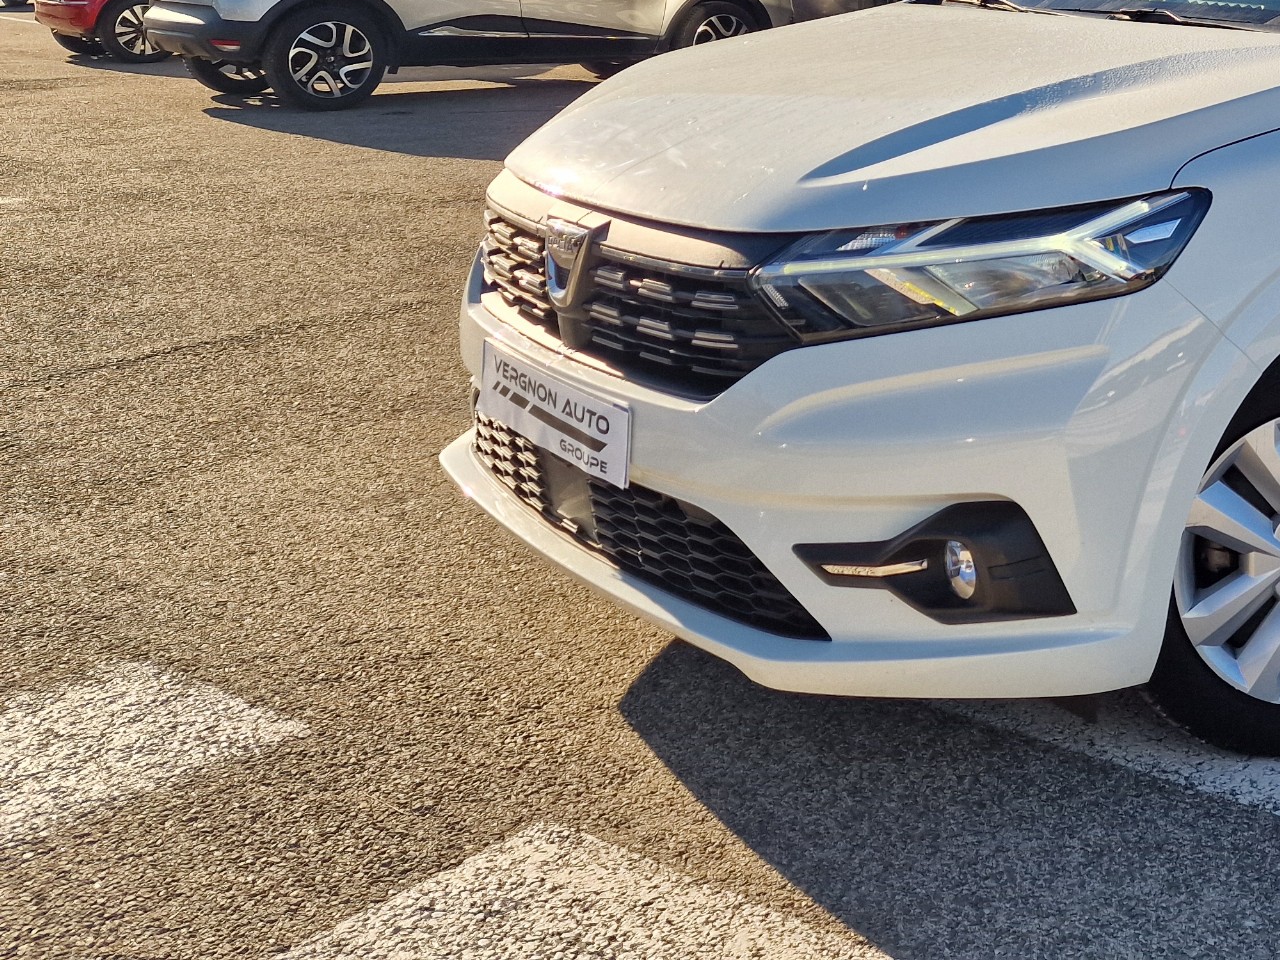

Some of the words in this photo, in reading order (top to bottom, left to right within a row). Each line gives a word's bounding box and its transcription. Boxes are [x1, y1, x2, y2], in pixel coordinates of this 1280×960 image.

[494, 354, 557, 409] VERGNON
[561, 398, 610, 435] AUTO
[559, 438, 608, 474] GROUPE
